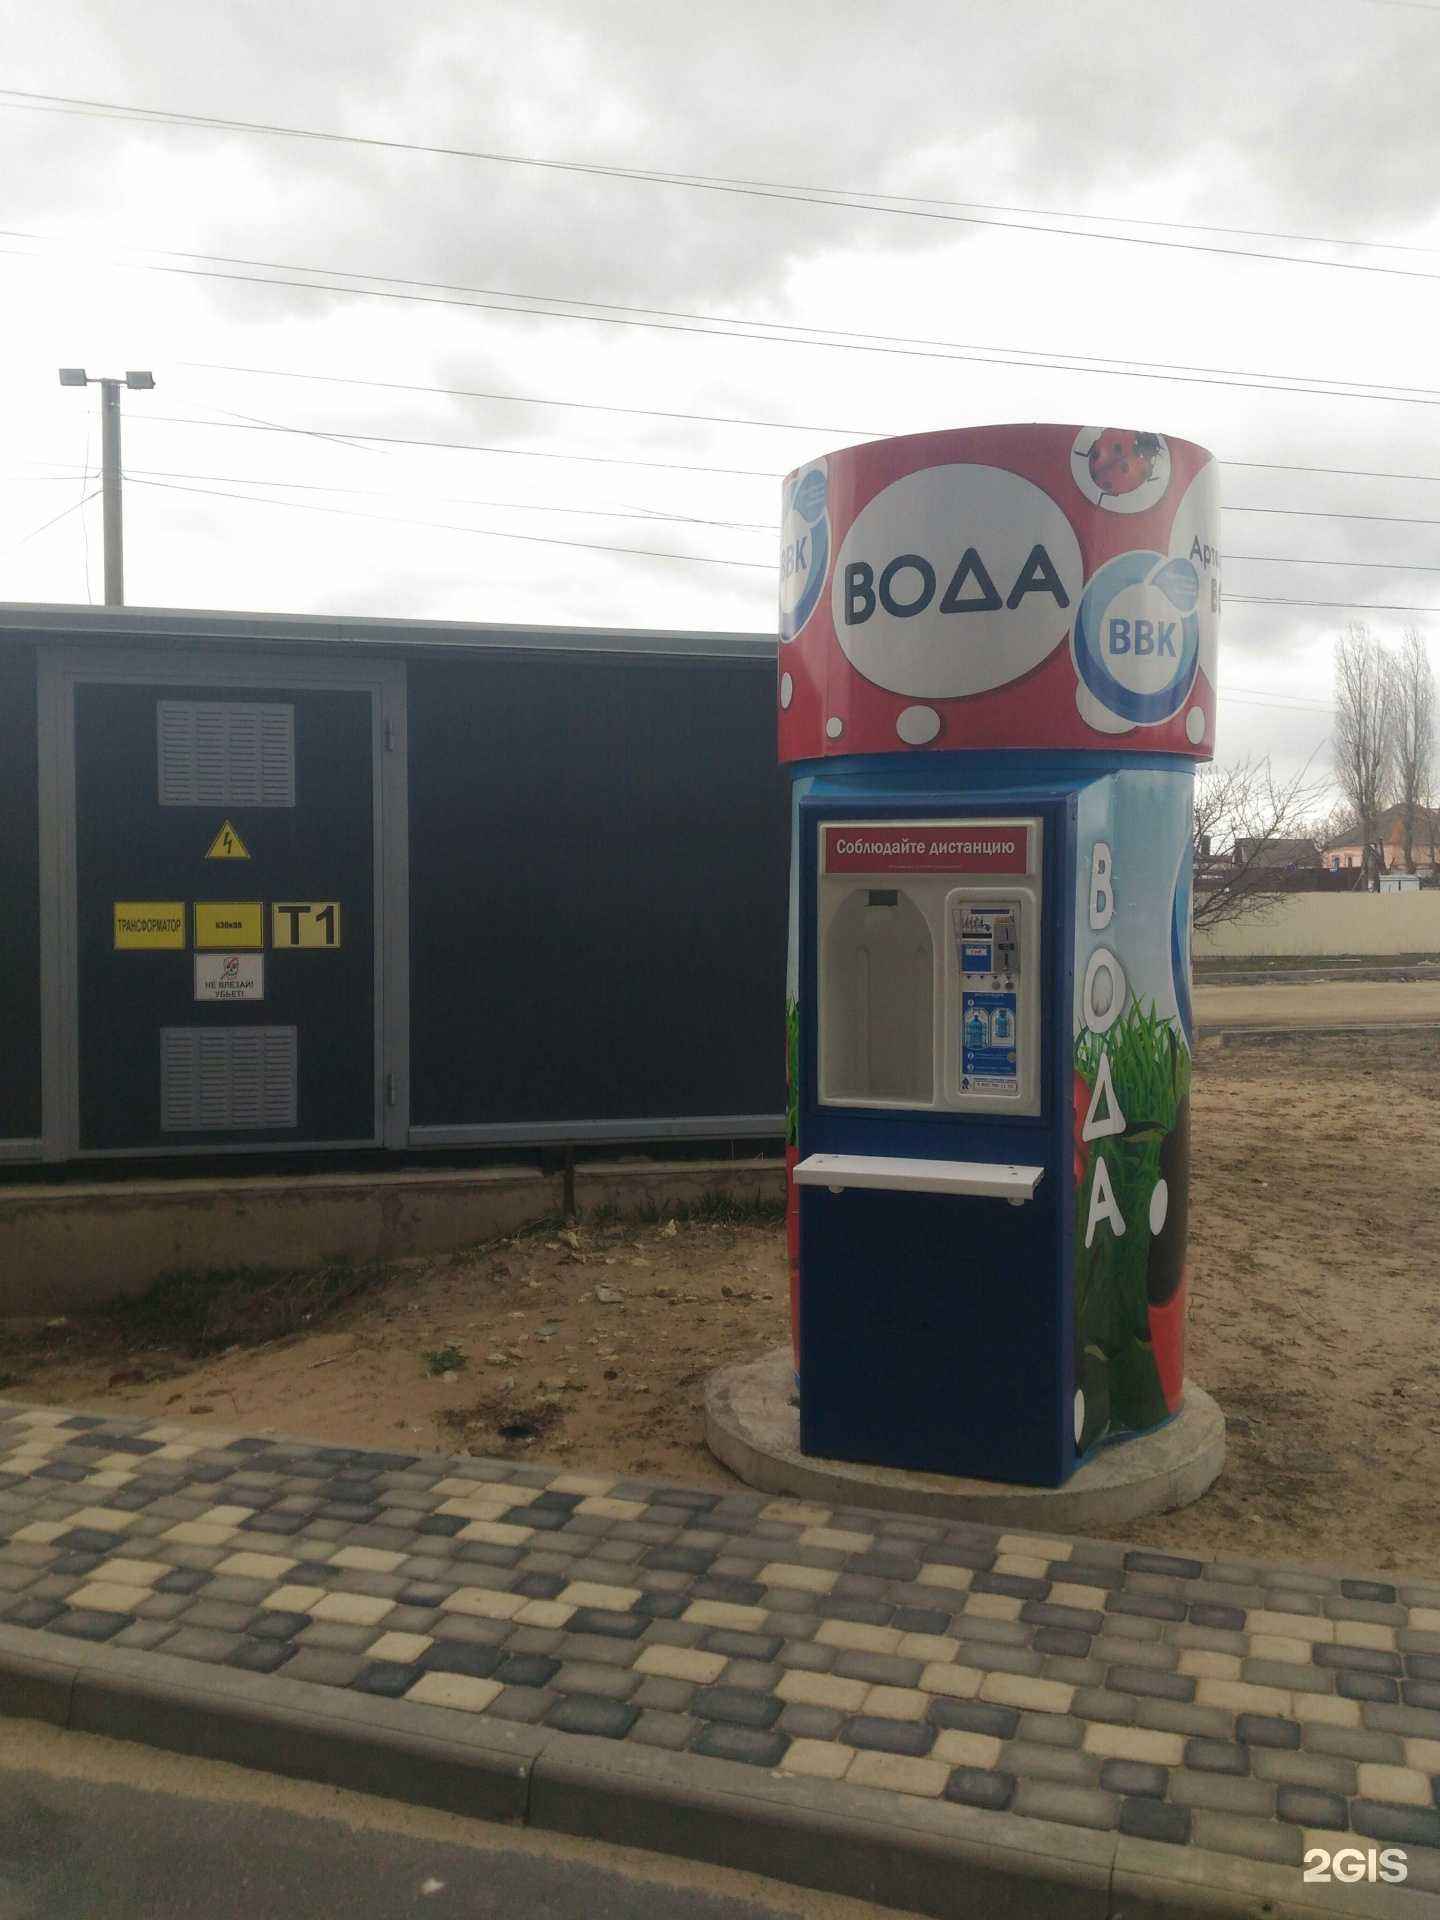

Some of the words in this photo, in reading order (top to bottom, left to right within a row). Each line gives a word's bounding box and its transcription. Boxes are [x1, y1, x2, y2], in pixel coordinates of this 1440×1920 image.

[844, 543, 1071, 626] ВОДА
[1108, 617, 1177, 657] ВВК
[836, 838, 926, 855] Соблюдайте
[929, 840, 1015, 856] дистанцию
[117, 918, 182, 933] ТРАНСФОРМАТОР
[278, 905, 335, 945] Т1
[1082, 841, 1127, 1248] ВОДА
